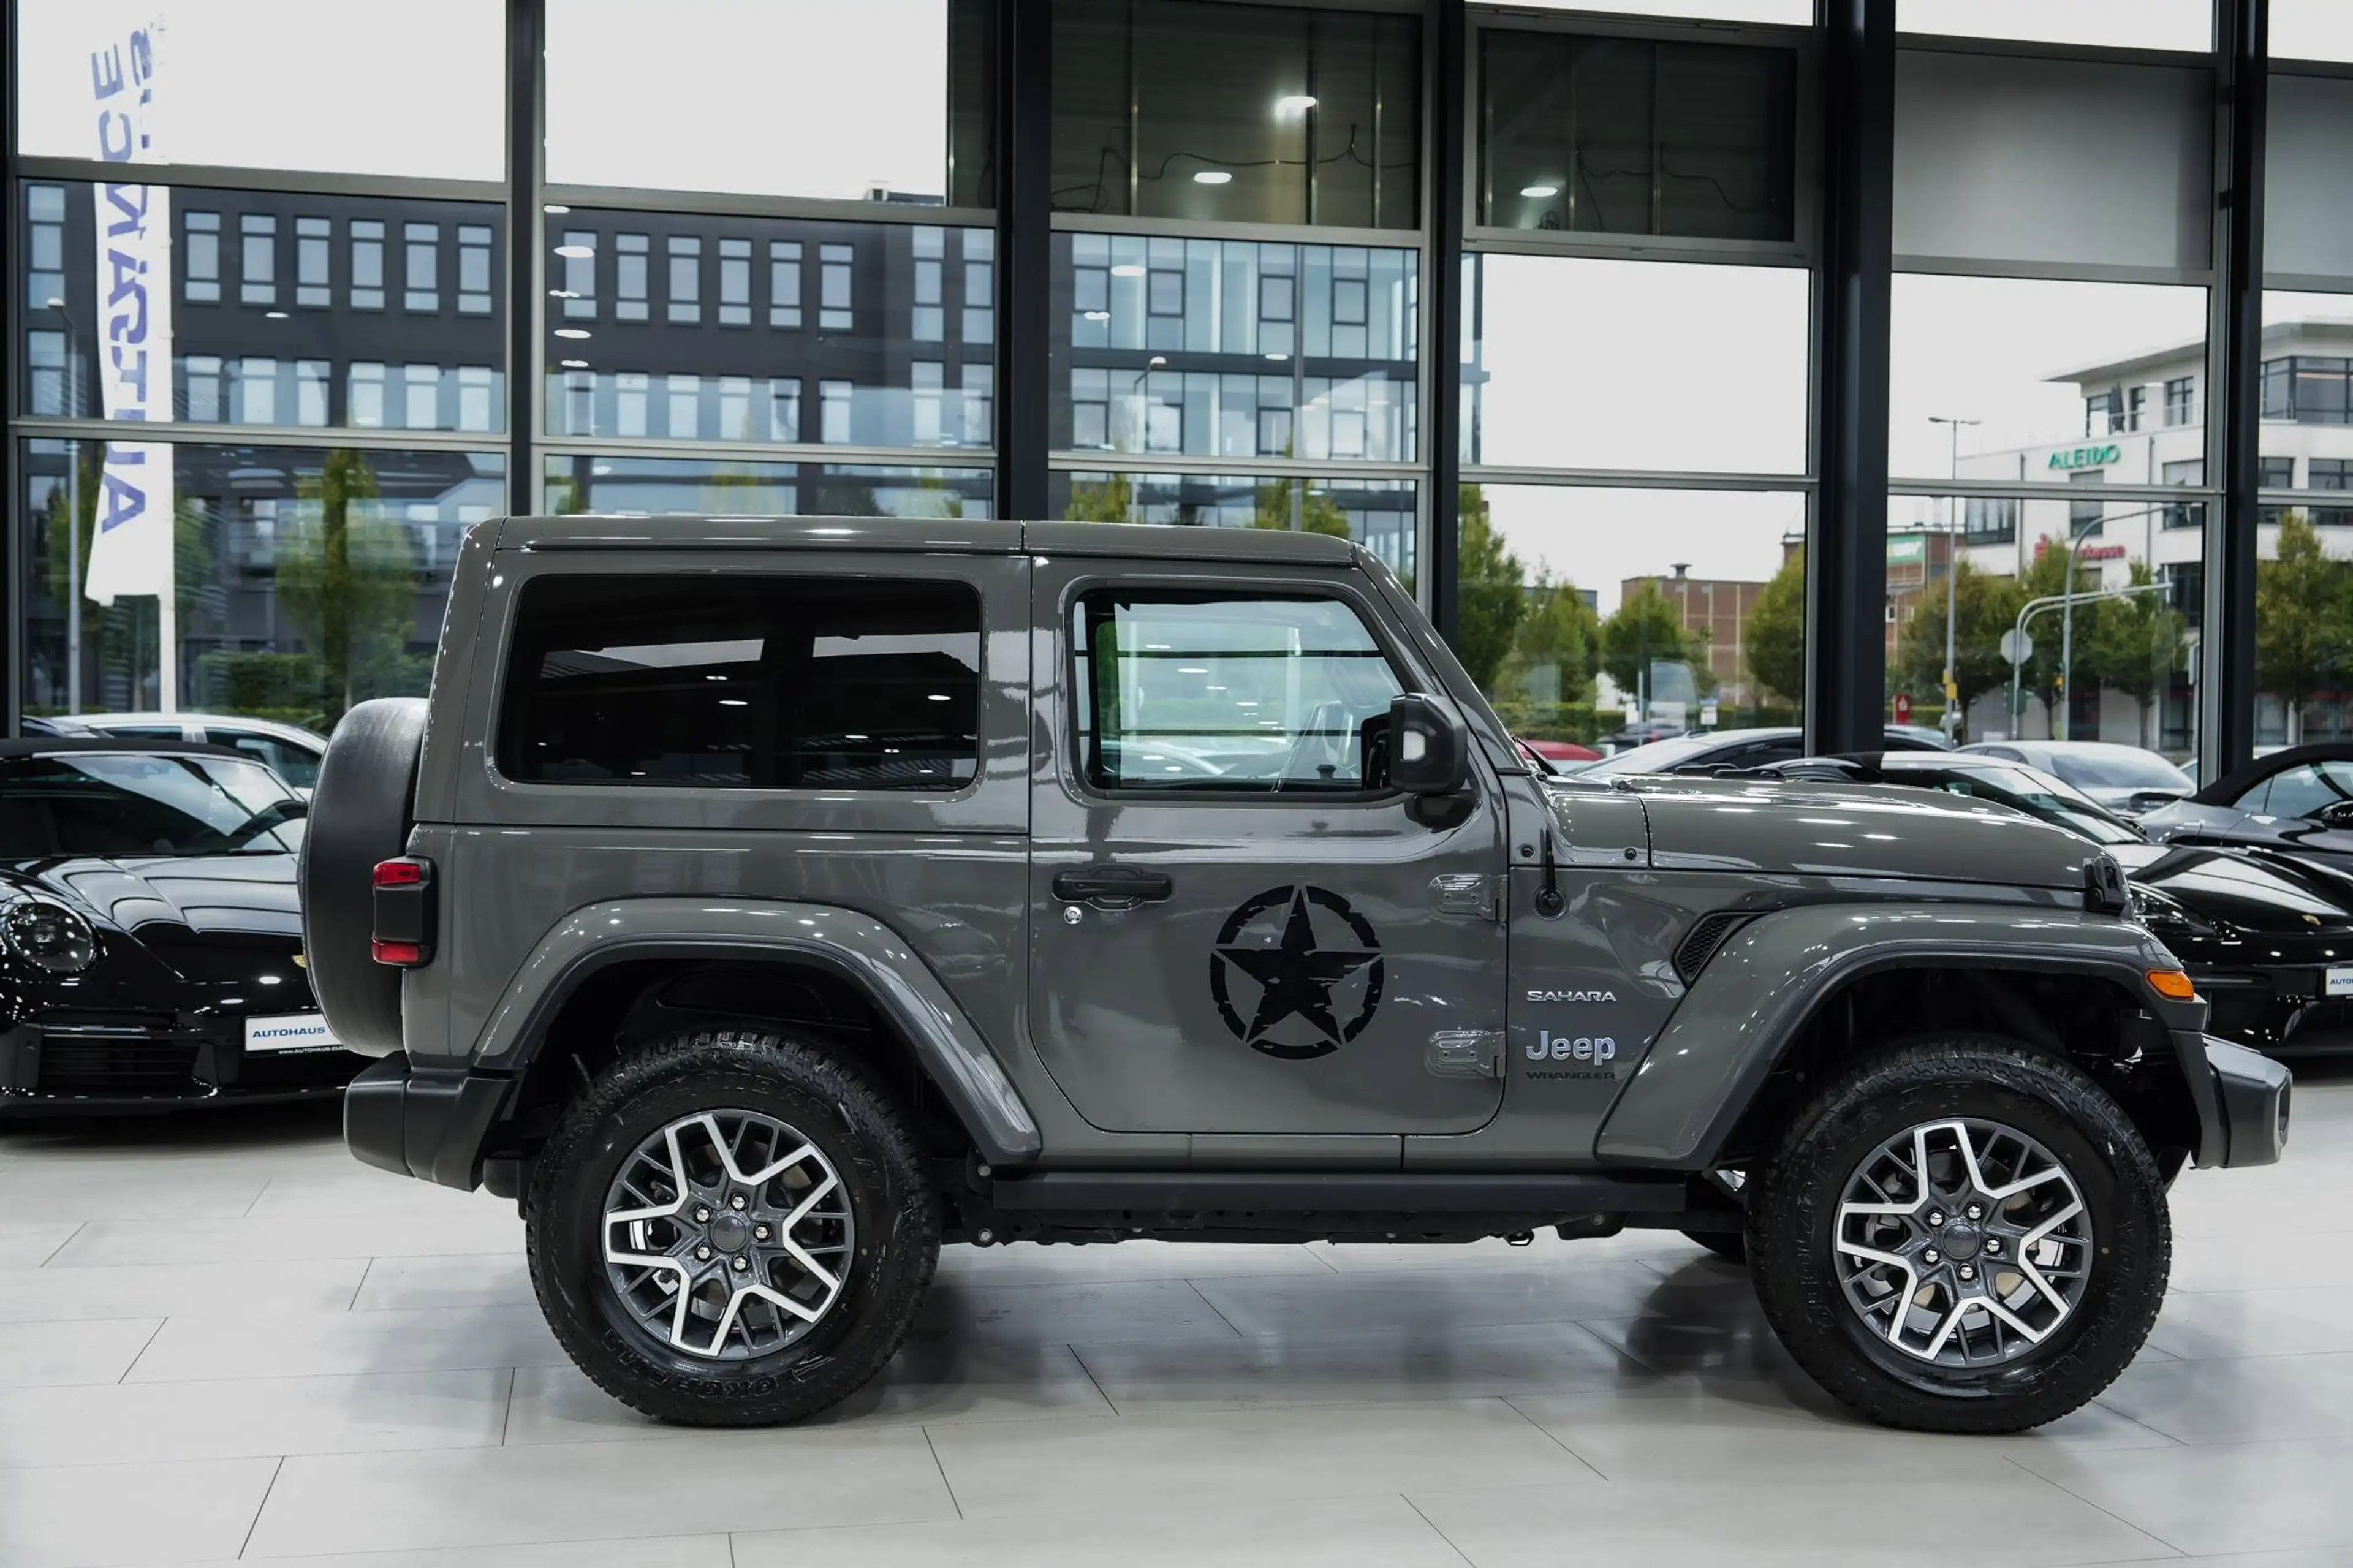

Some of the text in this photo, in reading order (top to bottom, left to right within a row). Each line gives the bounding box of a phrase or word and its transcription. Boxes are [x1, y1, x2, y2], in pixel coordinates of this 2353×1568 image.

[2048, 445, 2121, 469] ALEIDO
[1526, 991, 1616, 1002] SAHARA
[252, 1026, 326, 1038] AUTOHAUS
[1526, 1030, 1616, 1066] Jeep
[1526, 1072, 1615, 1080] WRANGLER
